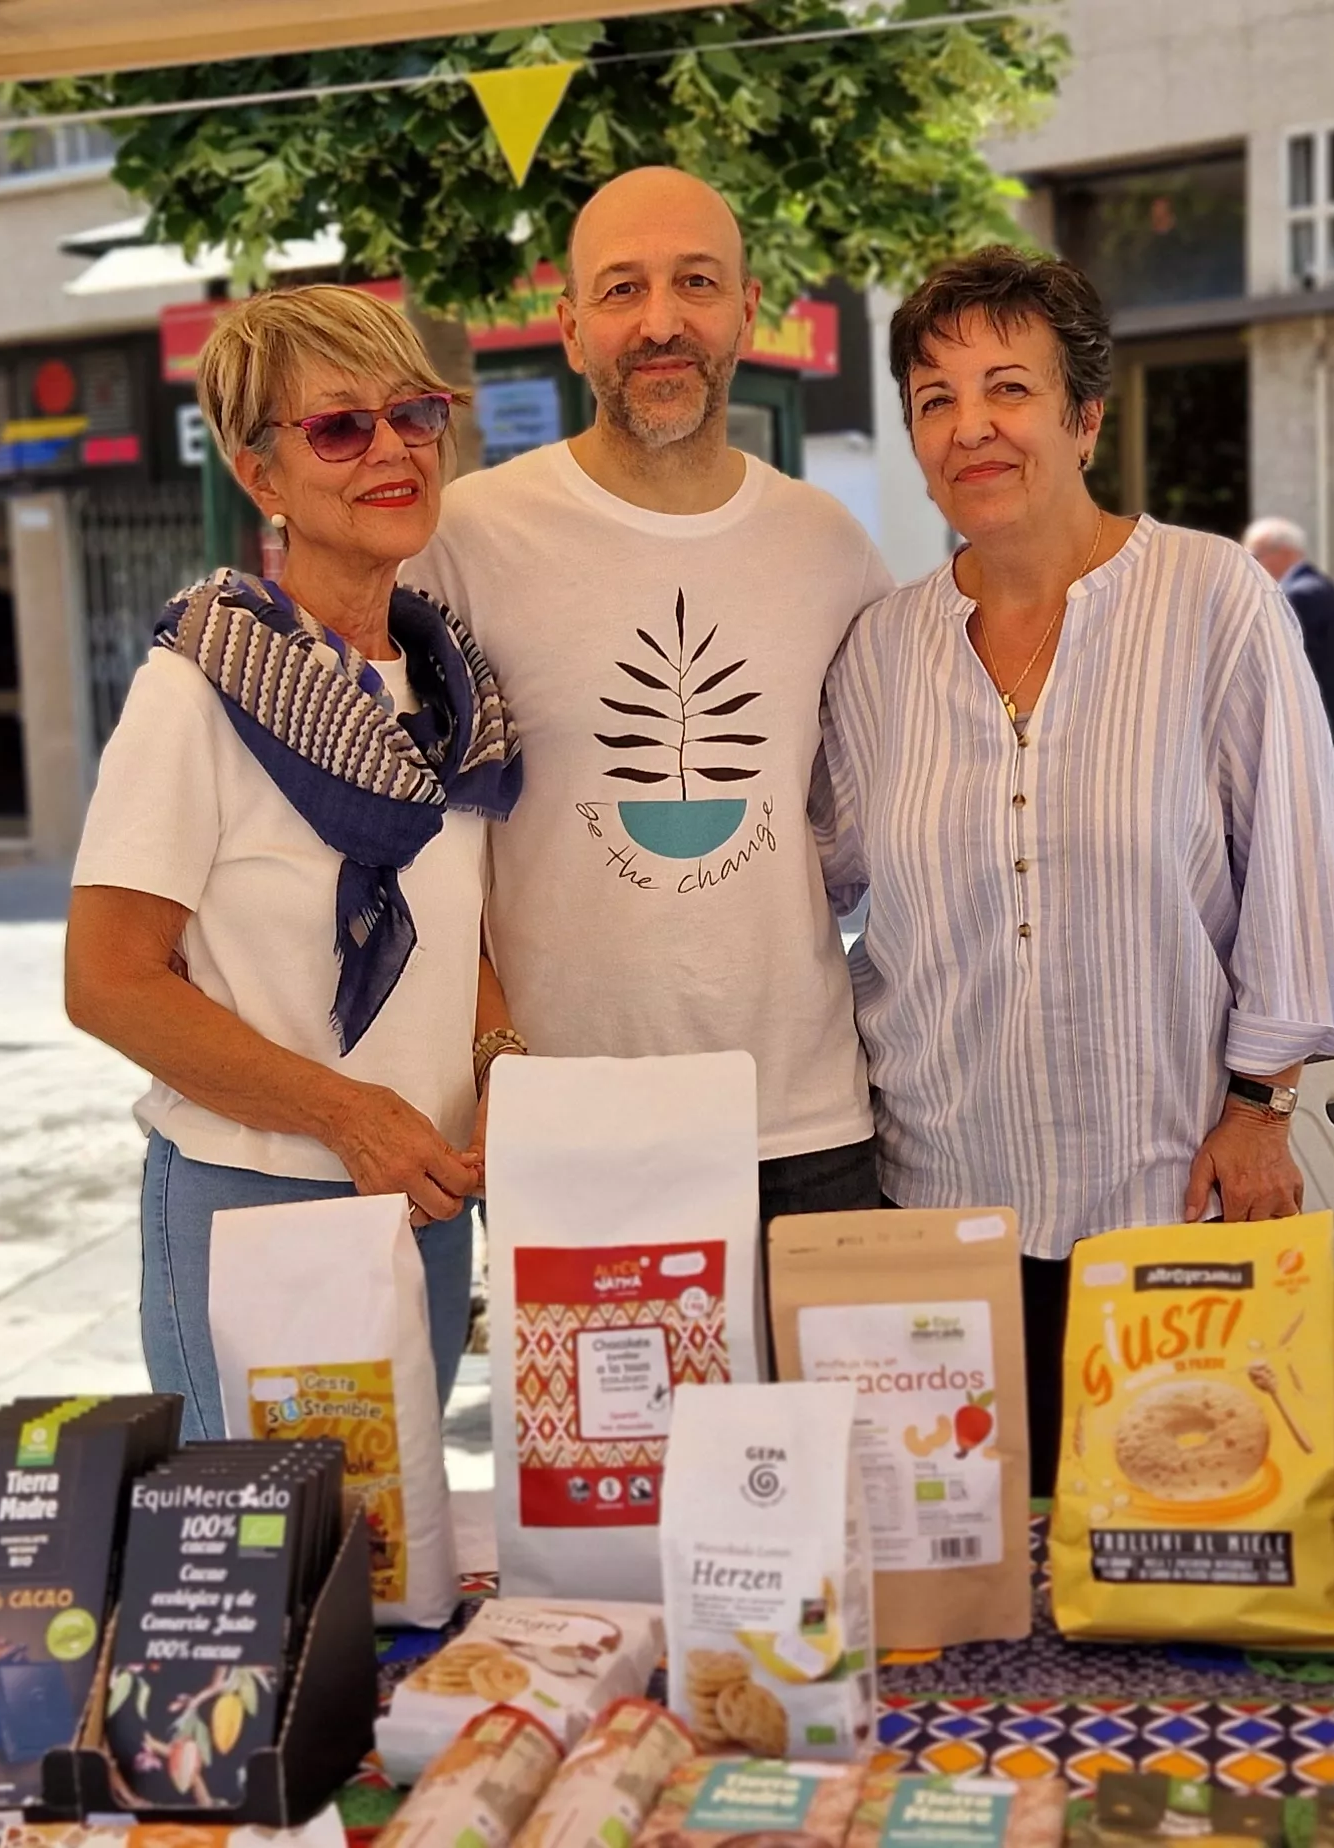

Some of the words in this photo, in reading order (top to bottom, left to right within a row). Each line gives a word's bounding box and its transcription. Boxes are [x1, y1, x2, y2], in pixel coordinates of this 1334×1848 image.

[575, 801, 613, 839] be
[606, 846, 661, 891] the
[678, 794, 777, 894] change
[592, 1338, 651, 1352] Chocolate
[304, 1374, 356, 1393] Cesta
[745, 1446, 787, 1462] GEPA
[5, 1470, 59, 1494] Tierra
[179, 1513, 236, 1540] 100%
[180, 1540, 228, 1555] cacao
[1094, 1533, 1182, 1551] FROLLINI
[1193, 1535, 1214, 1553] AL
[1227, 1535, 1286, 1554] MIELE
[8, 1555, 34, 1569] BIO
[179, 1565, 228, 1583] Cacao
[692, 1558, 783, 1592] Herzen
[8, 1589, 74, 1610] CACAO
[151, 1590, 221, 1611] ecológico
[234, 1590, 256, 1608] de
[140, 1613, 210, 1632] Comercio
[212, 1613, 257, 1635] Justo
[145, 1640, 190, 1660] 100%
[192, 1642, 243, 1660] cacao
[725, 1772, 802, 1792] Tierra
[711, 1787, 799, 1808] Madre
[913, 1788, 994, 1808] Tierra
[903, 1805, 994, 1825] Madre
